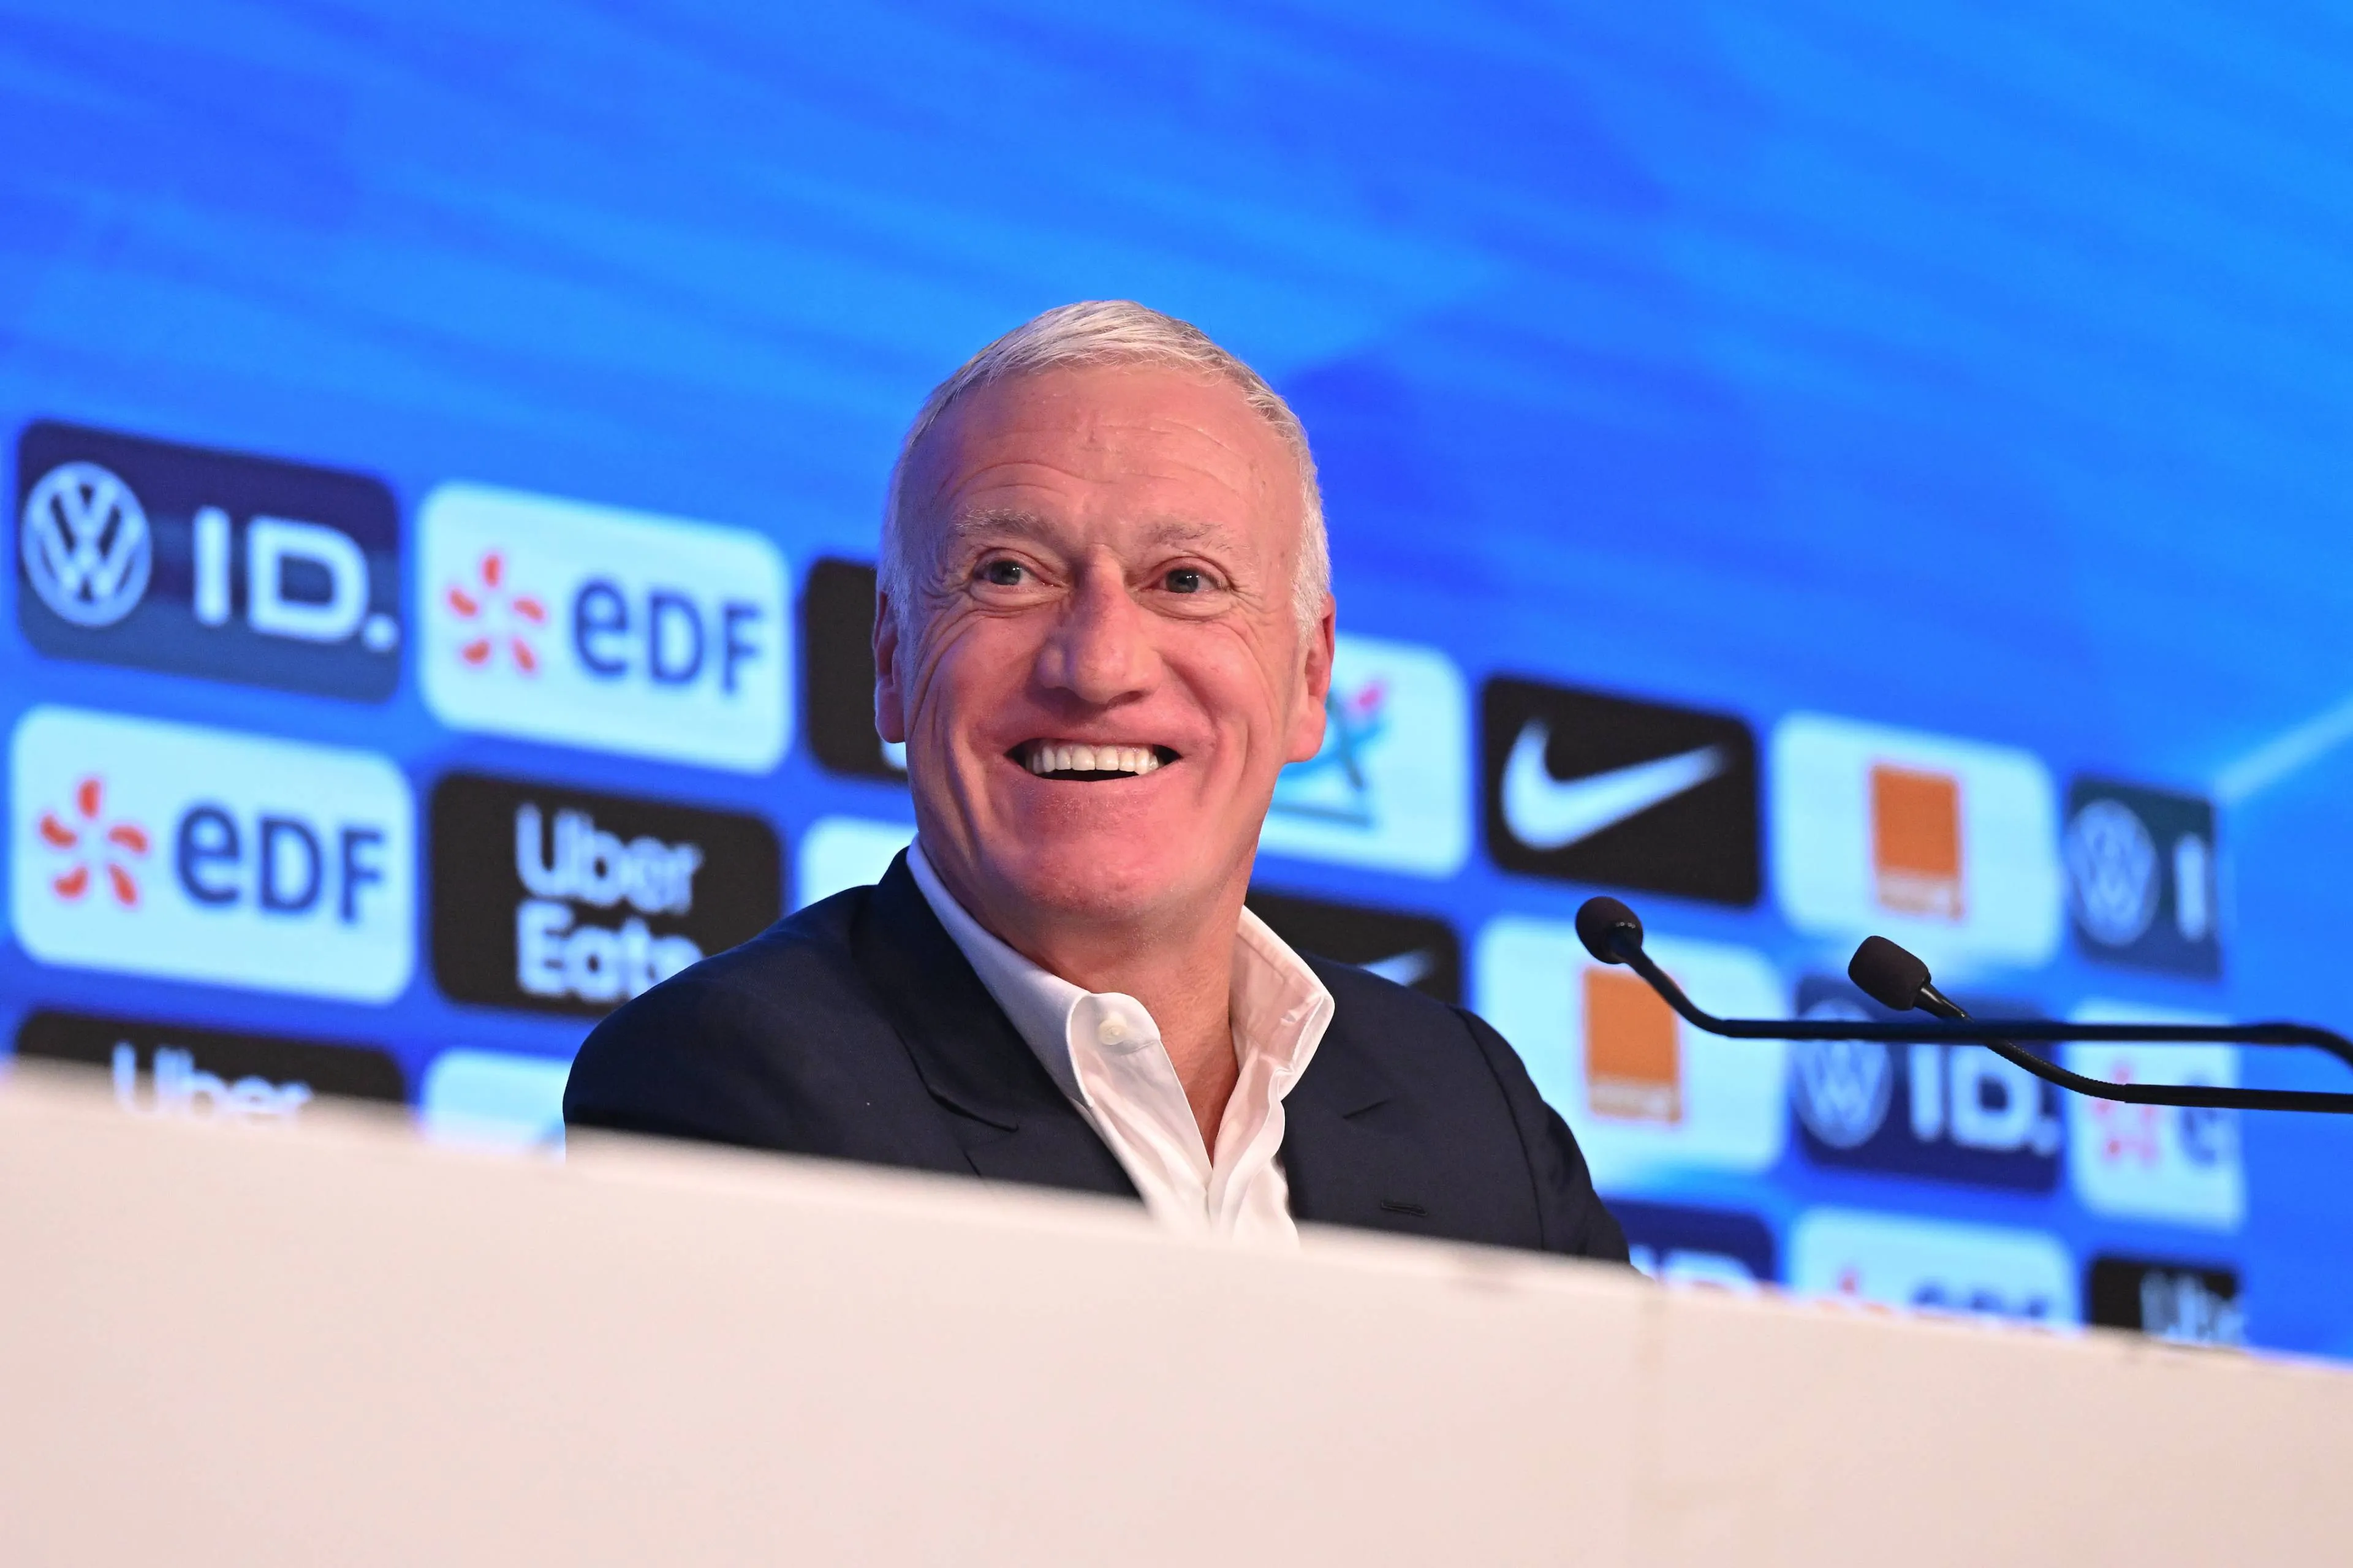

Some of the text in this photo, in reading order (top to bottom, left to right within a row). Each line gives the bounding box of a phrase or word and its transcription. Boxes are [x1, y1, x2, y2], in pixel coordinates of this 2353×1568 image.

[193, 505, 399, 652] ID.
[570, 576, 762, 696] eDF
[176, 801, 385, 924] eDF
[515, 802, 703, 914] Uber
